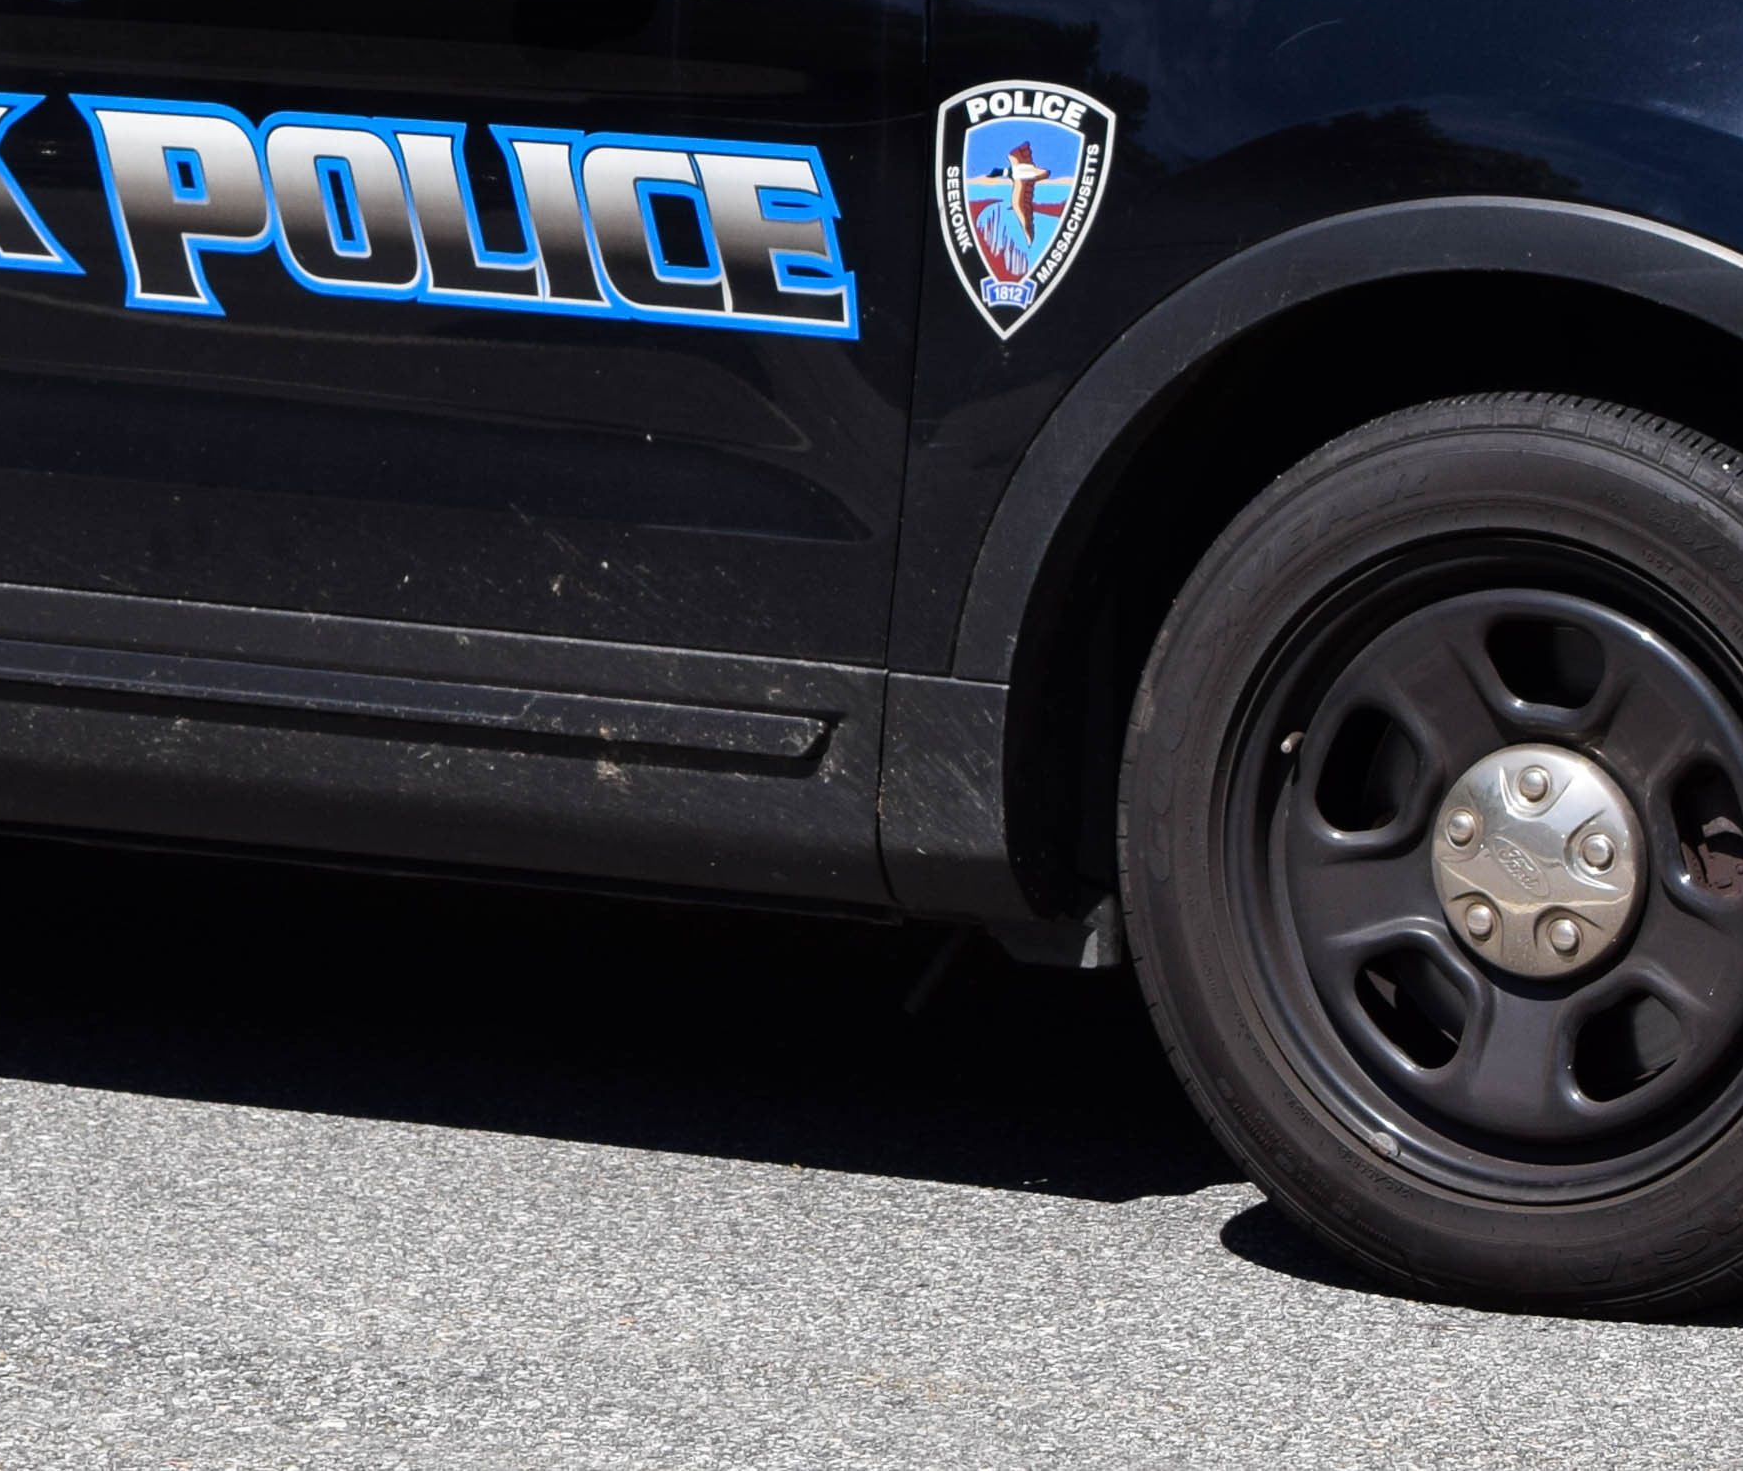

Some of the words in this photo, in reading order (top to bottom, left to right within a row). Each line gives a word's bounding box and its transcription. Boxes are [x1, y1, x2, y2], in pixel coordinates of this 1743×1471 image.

[965, 90, 1087, 128] POLICE
[69, 93, 858, 339] POLICE
[946, 165, 974, 255] SEEKONK
[1036, 143, 1099, 285] MASSACHUSETTS
[993, 286, 1023, 303] 1812
